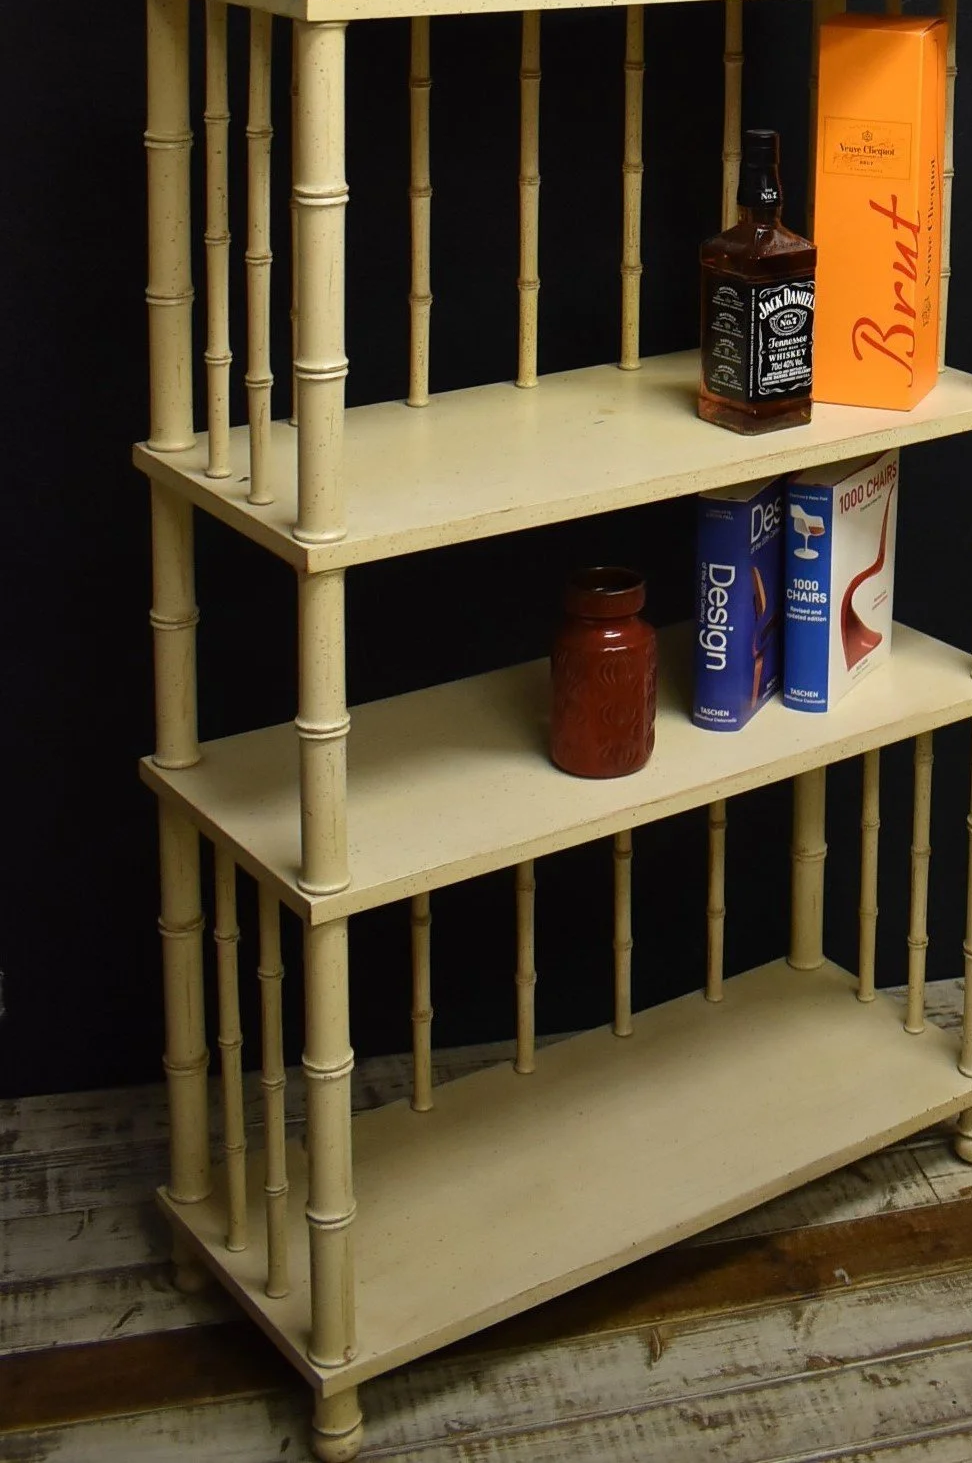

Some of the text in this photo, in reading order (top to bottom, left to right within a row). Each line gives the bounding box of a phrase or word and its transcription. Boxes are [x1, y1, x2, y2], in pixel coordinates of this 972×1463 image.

[839, 142, 861, 154] Veuve
[863, 144, 895, 157] Clicquot
[851, 193, 921, 388] Brut
[758, 294, 784, 320] JACK
[768, 335, 808, 349] Tennessee
[769, 348, 807, 362] WHISKEY
[839, 484, 864, 515] 1000
[866, 460, 897, 499] CHAIRS
[792, 578, 819, 592] 1000
[786, 588, 828, 604] CHAIRS
[698, 563, 736, 671] Design
[789, 687, 819, 698] TASCHEN
[700, 706, 730, 717] TASCHEN
